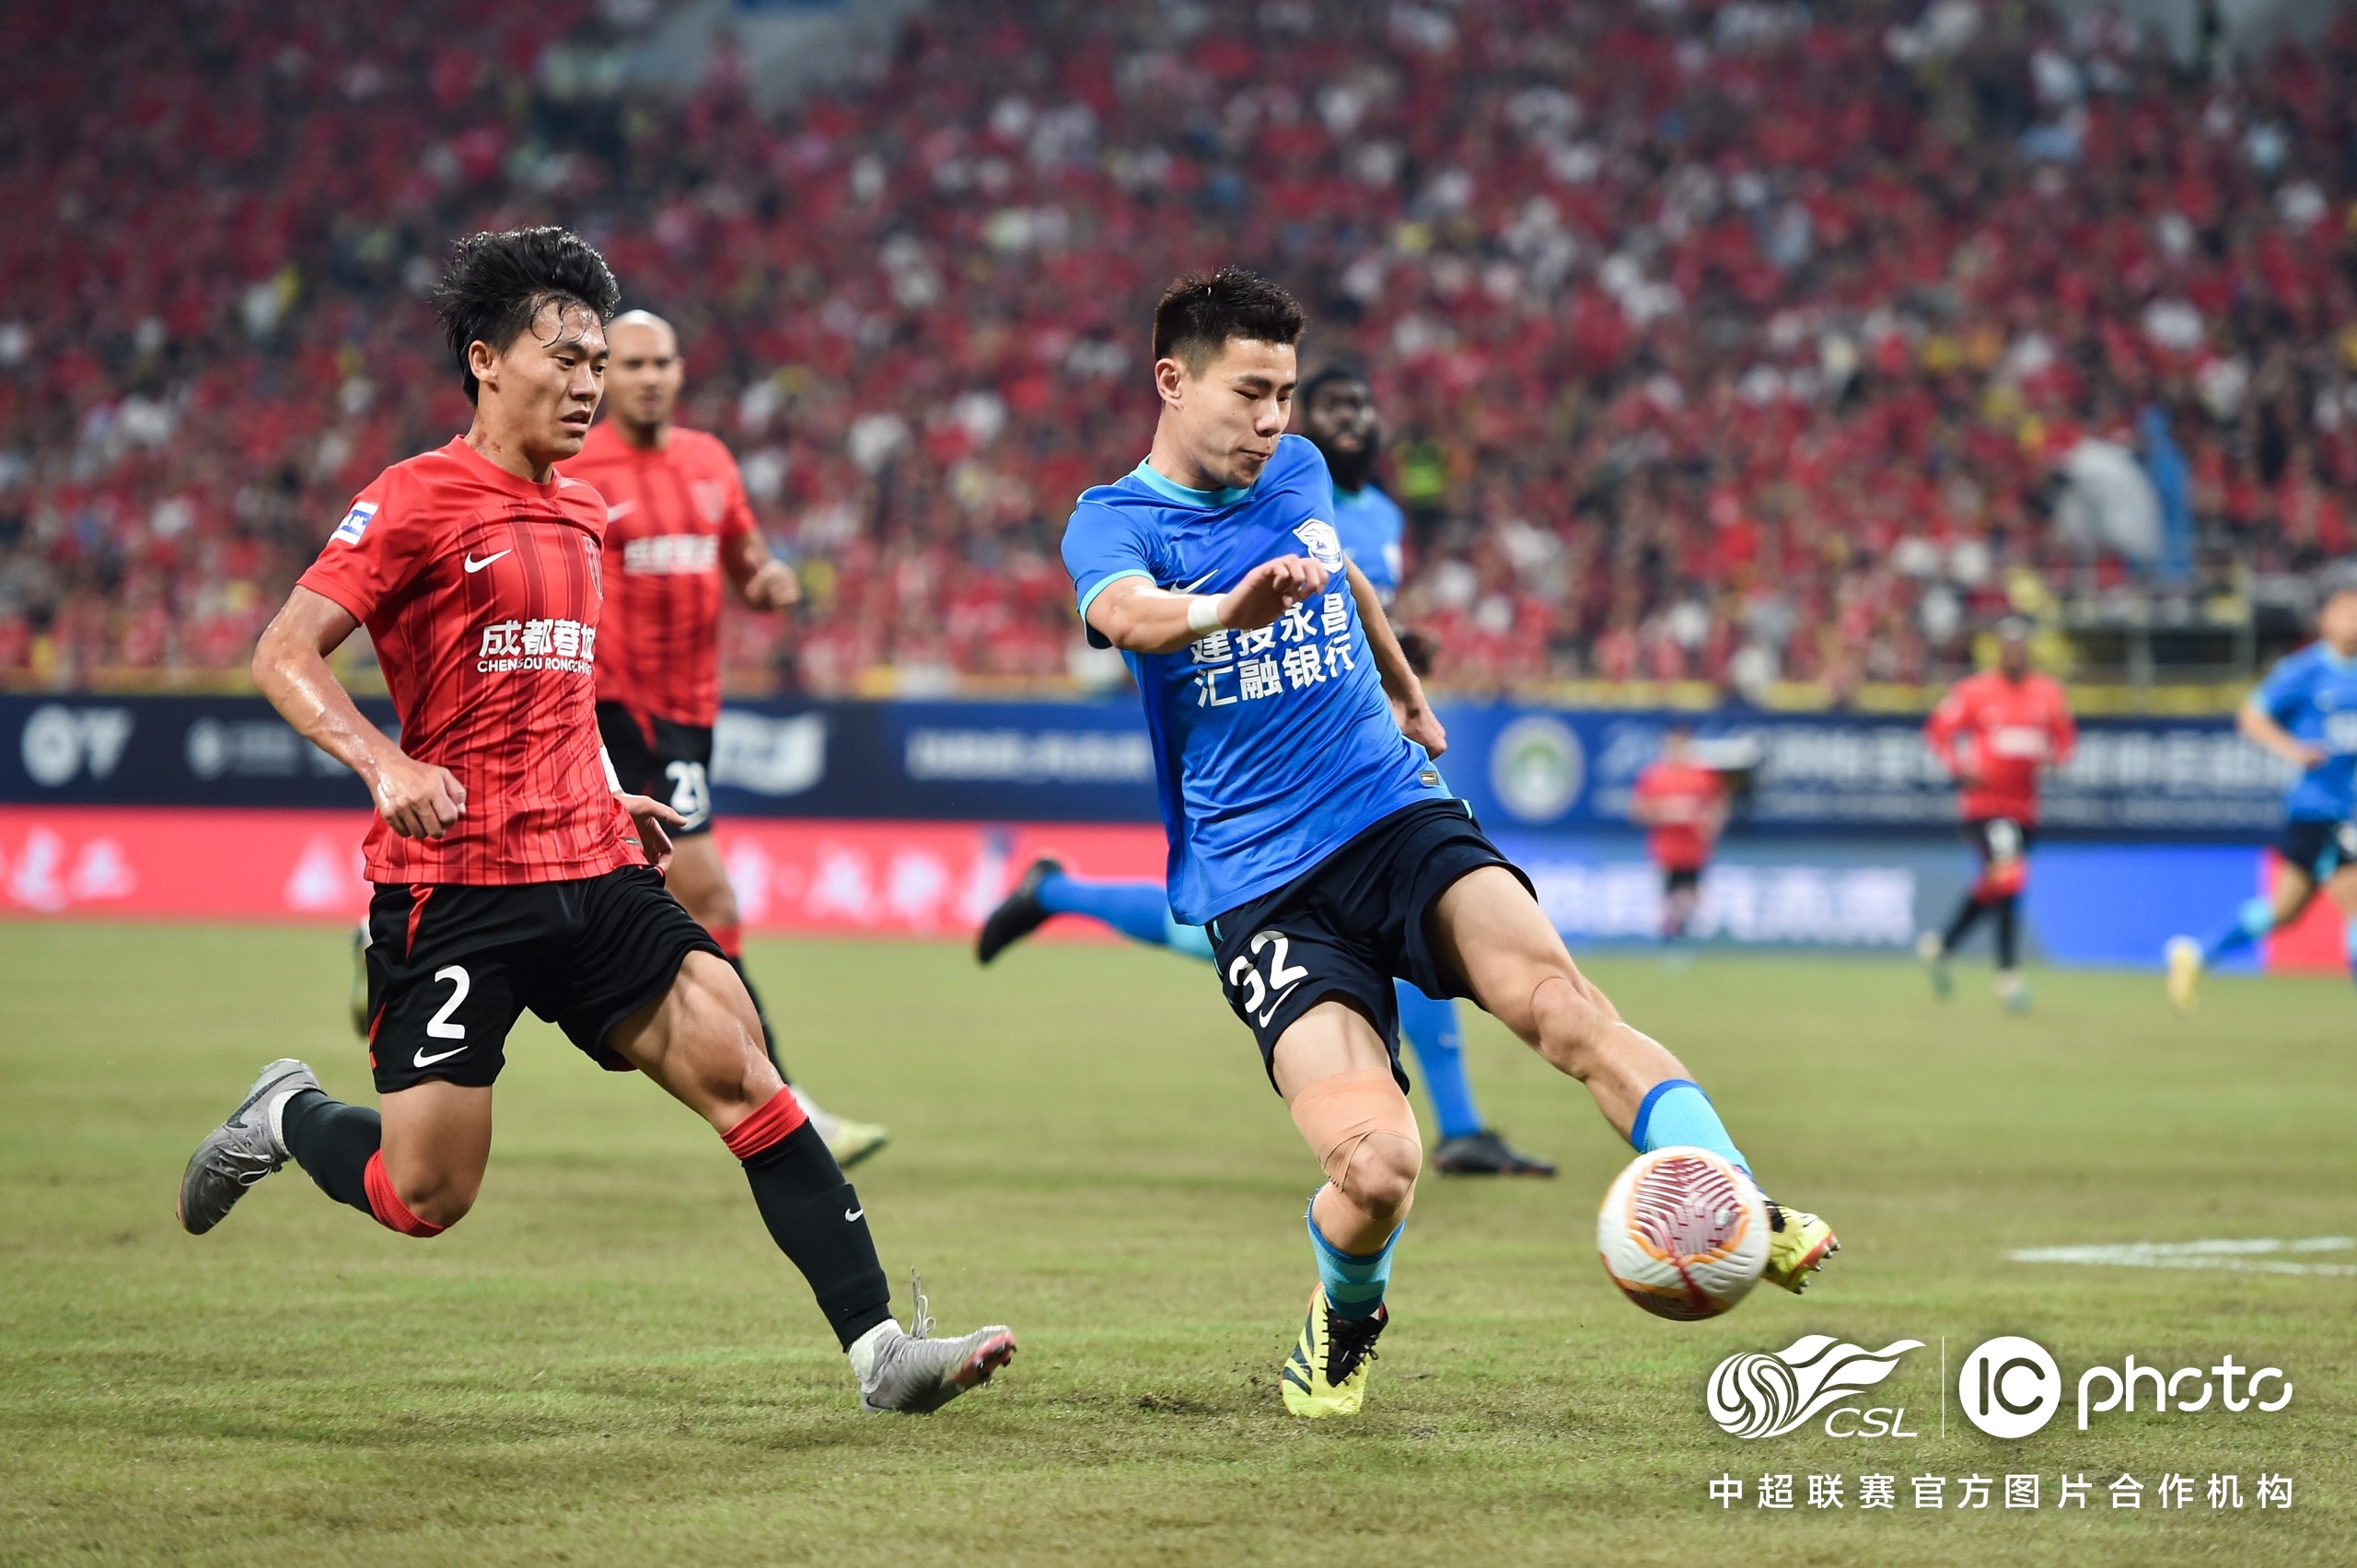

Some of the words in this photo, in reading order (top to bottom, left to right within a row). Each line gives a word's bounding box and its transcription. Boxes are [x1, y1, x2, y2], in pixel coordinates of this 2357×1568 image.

[478, 619, 597, 663] 成都蓉城
[1190, 592, 1349, 665] 建投永昌
[1194, 633, 1355, 708] 汇融银行
[426, 965, 470, 1040] 2
[1229, 930, 1308, 1013] 32
